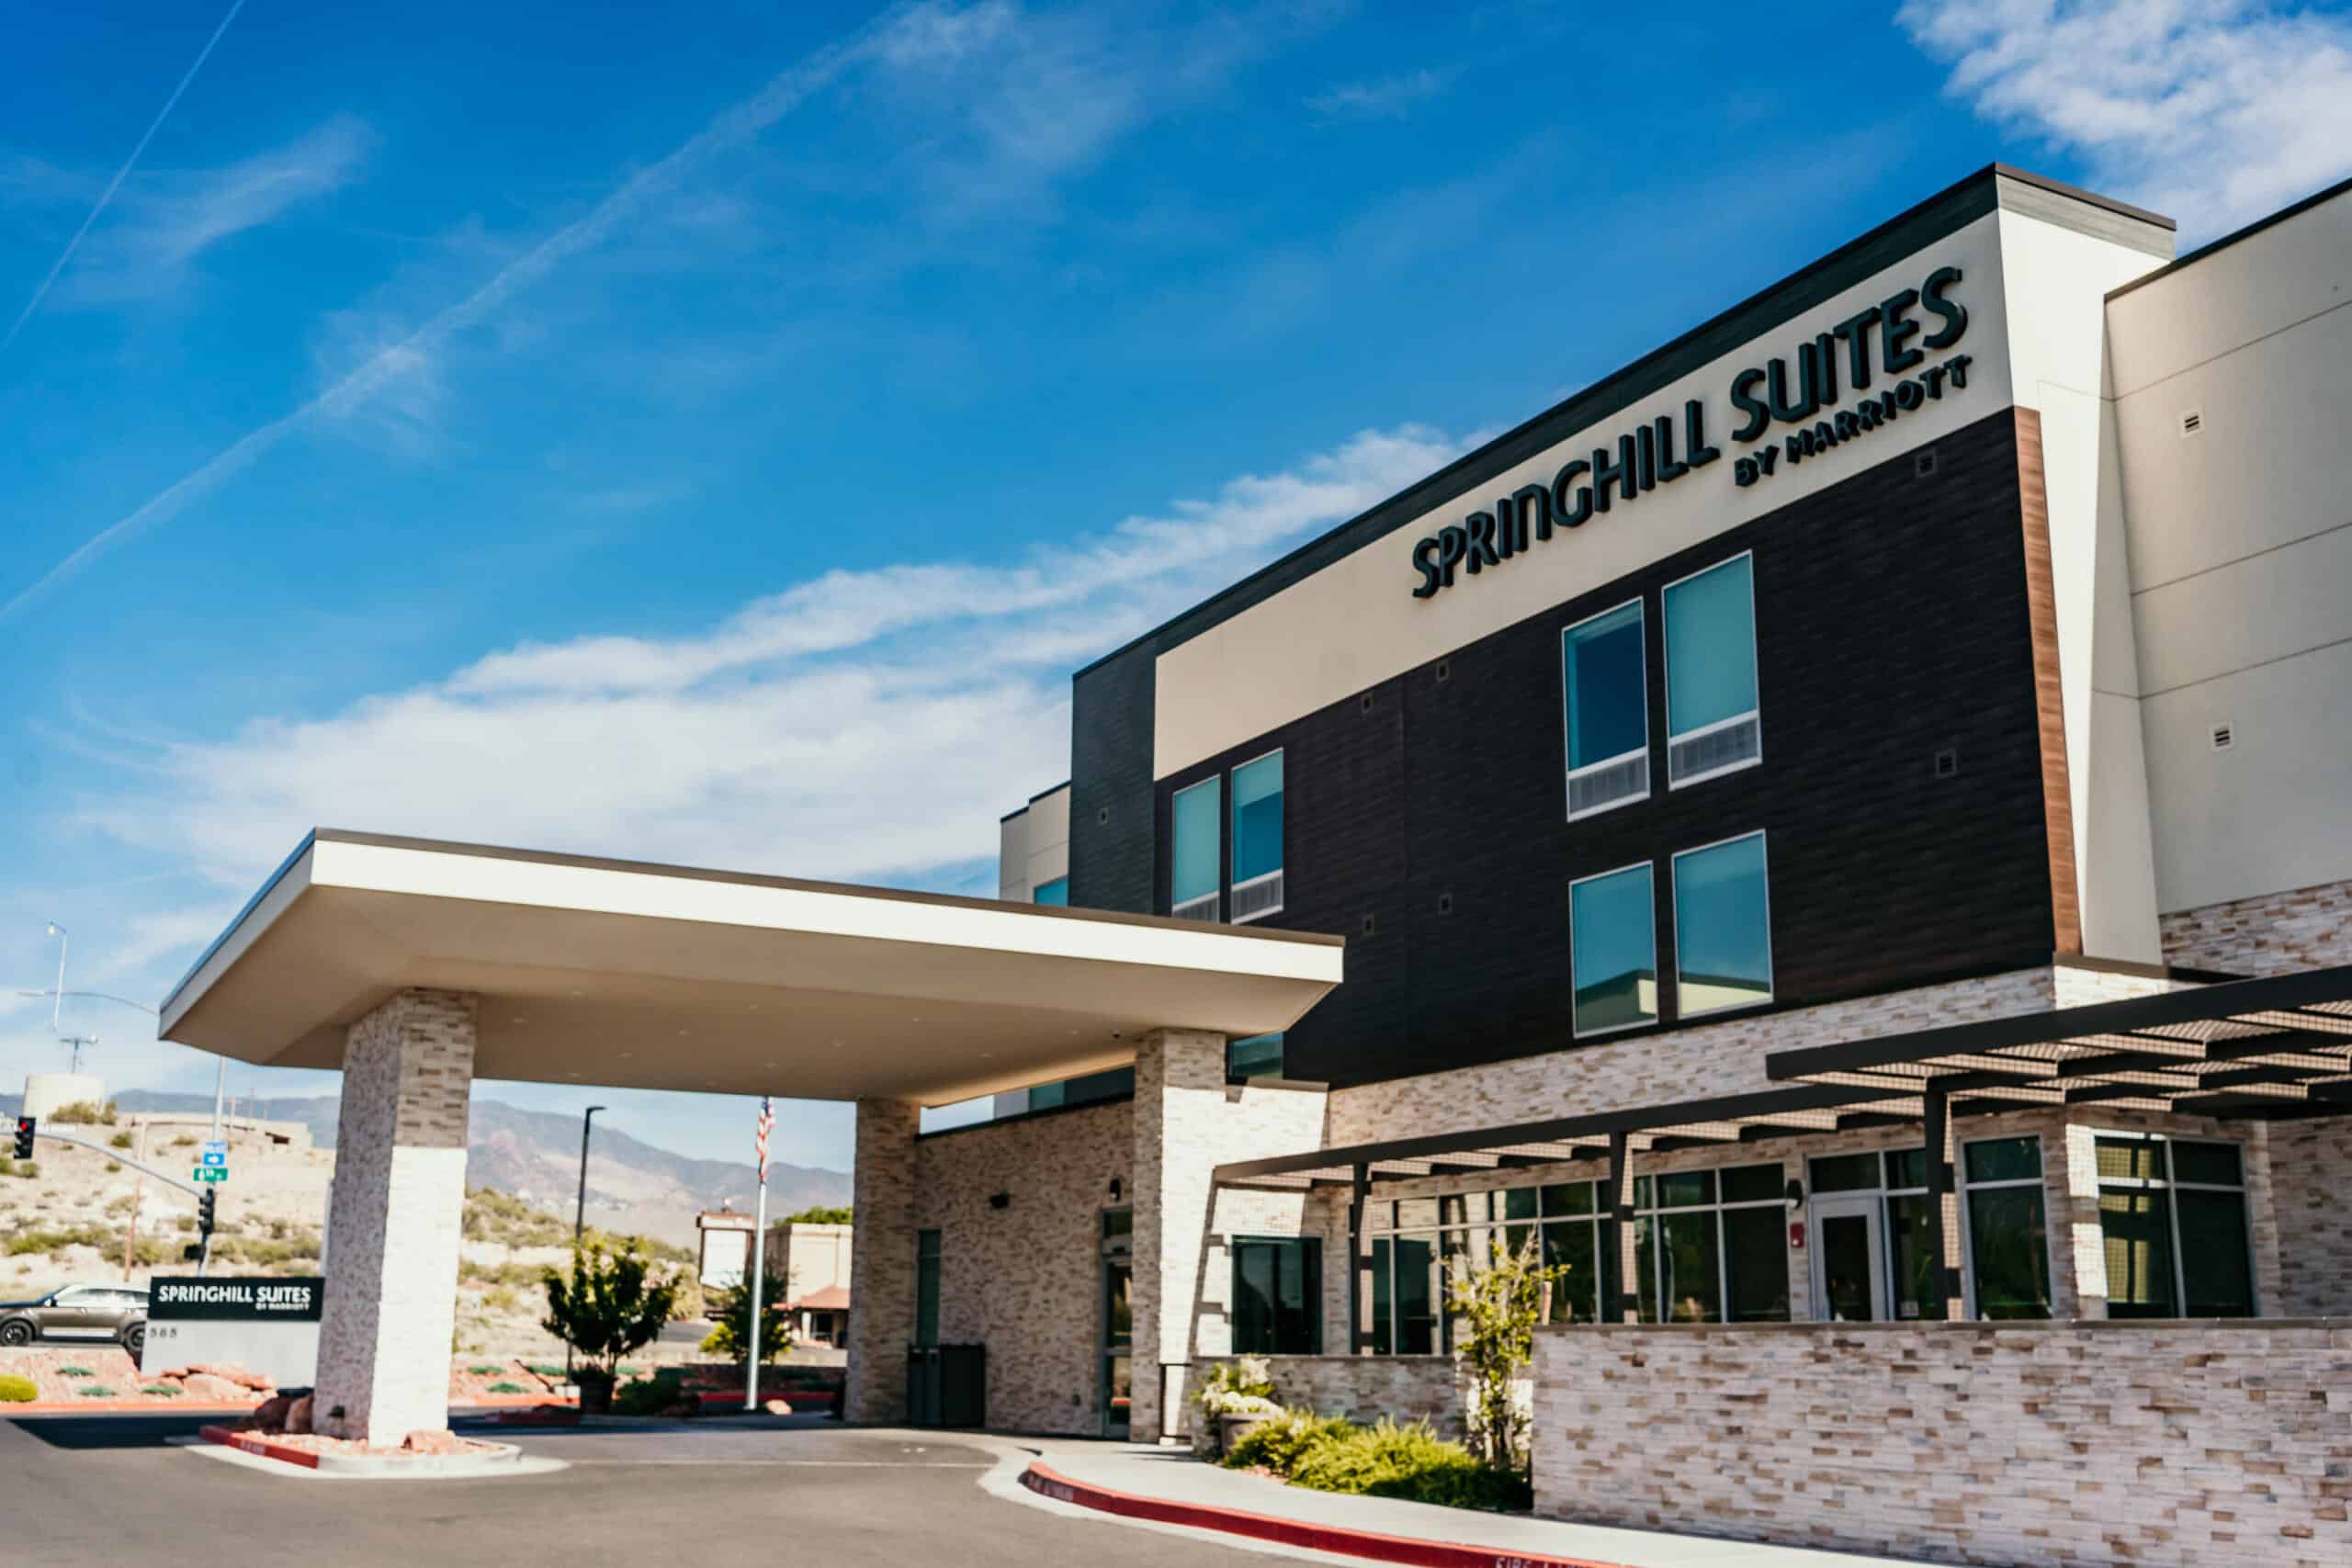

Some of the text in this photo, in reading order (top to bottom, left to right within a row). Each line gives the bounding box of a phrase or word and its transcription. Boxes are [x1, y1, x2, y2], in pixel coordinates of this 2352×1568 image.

[1412, 265, 1968, 599] SPRINGHILL SUITES
[1735, 355, 1973, 487] BY MARRIOTT
[158, 1286, 311, 1303] SPRINGHILL SUITES
